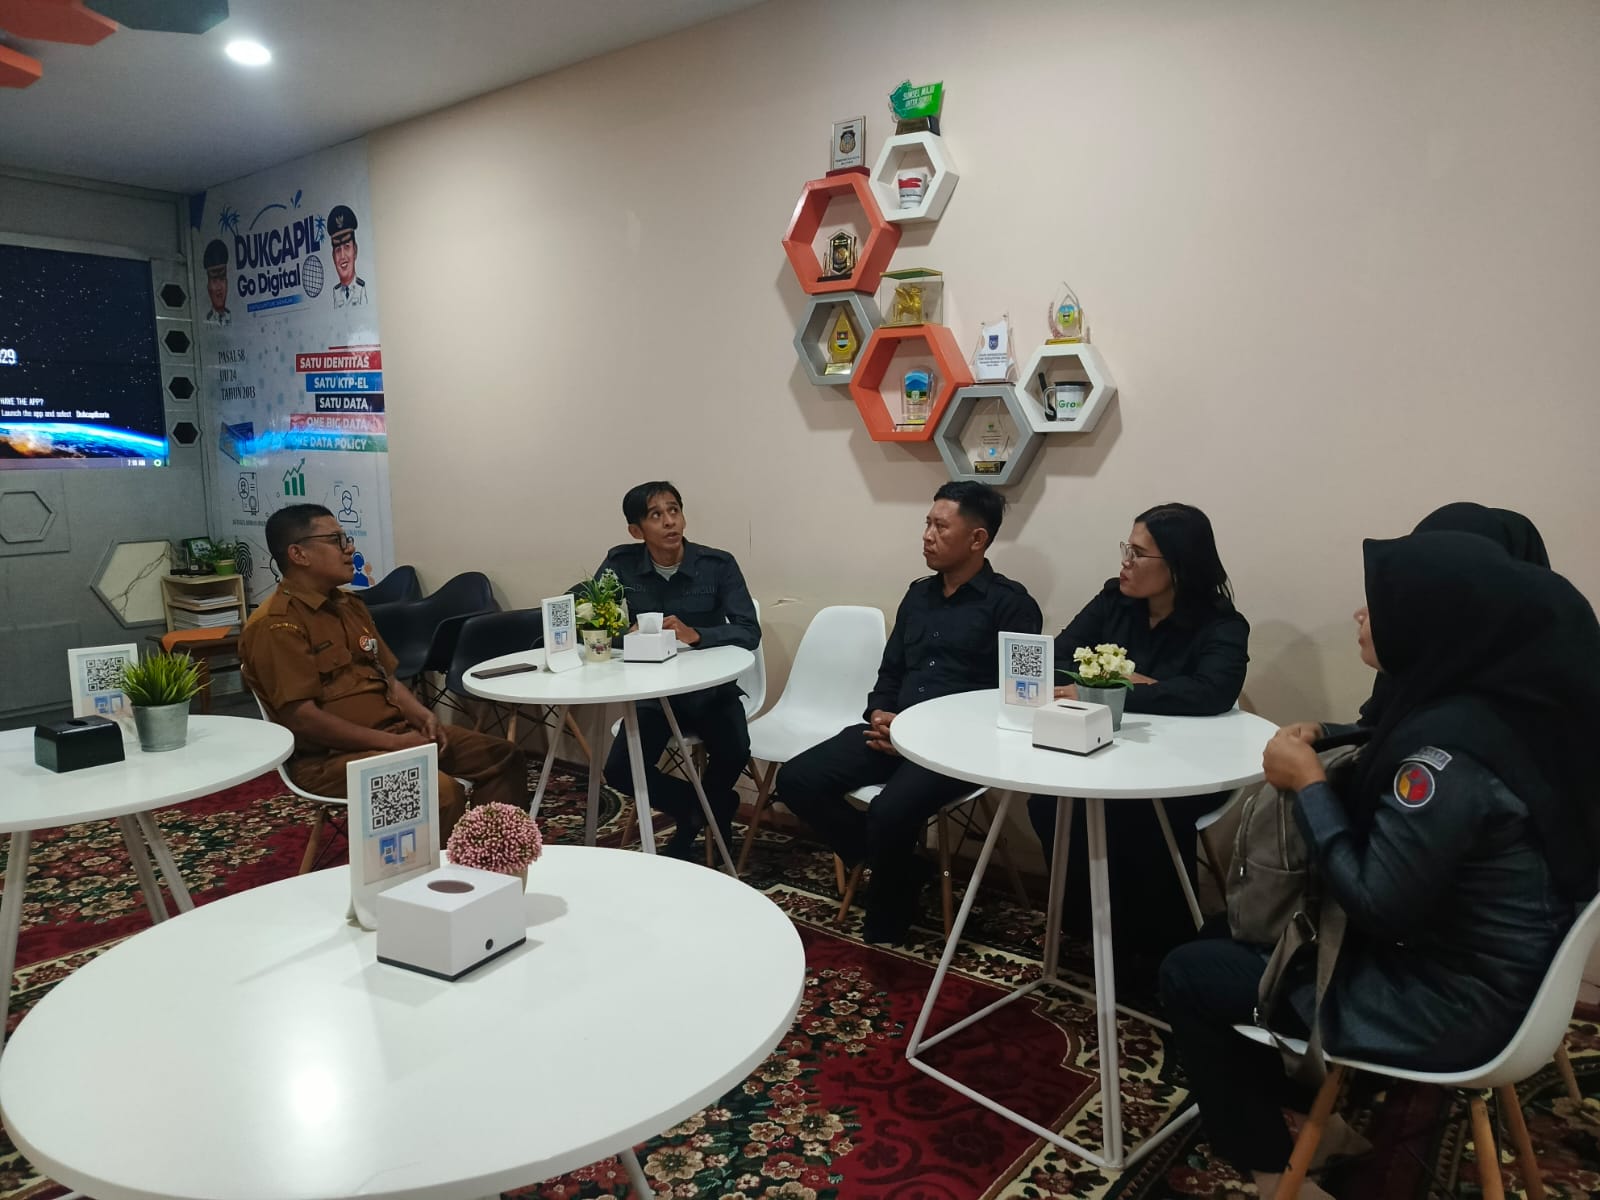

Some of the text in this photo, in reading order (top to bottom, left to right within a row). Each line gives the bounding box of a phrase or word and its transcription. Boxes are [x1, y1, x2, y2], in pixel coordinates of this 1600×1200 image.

[235, 215, 321, 271] DUKCAPIL
[237, 263, 301, 298] Go Digital
[218, 350, 237, 364] PASAL
[300, 355, 370, 369] SATU IDENTITAS
[314, 376, 368, 389] SATU KTP-EL
[221, 385, 256, 401] TAHUN 2013
[16, 397, 28, 406] THE
[29, 397, 44, 406] APP?
[319, 397, 369, 410] SATU DATA
[1, 409, 22, 417] Launch
[22, 409, 32, 417] the
[33, 411, 44, 419] app
[44, 410, 55, 418] and
[56, 410, 72, 418] select
[307, 416, 368, 430] ONE BIG DATA
[310, 436, 333, 448] DATA
[335, 438, 367, 450] POLICY
